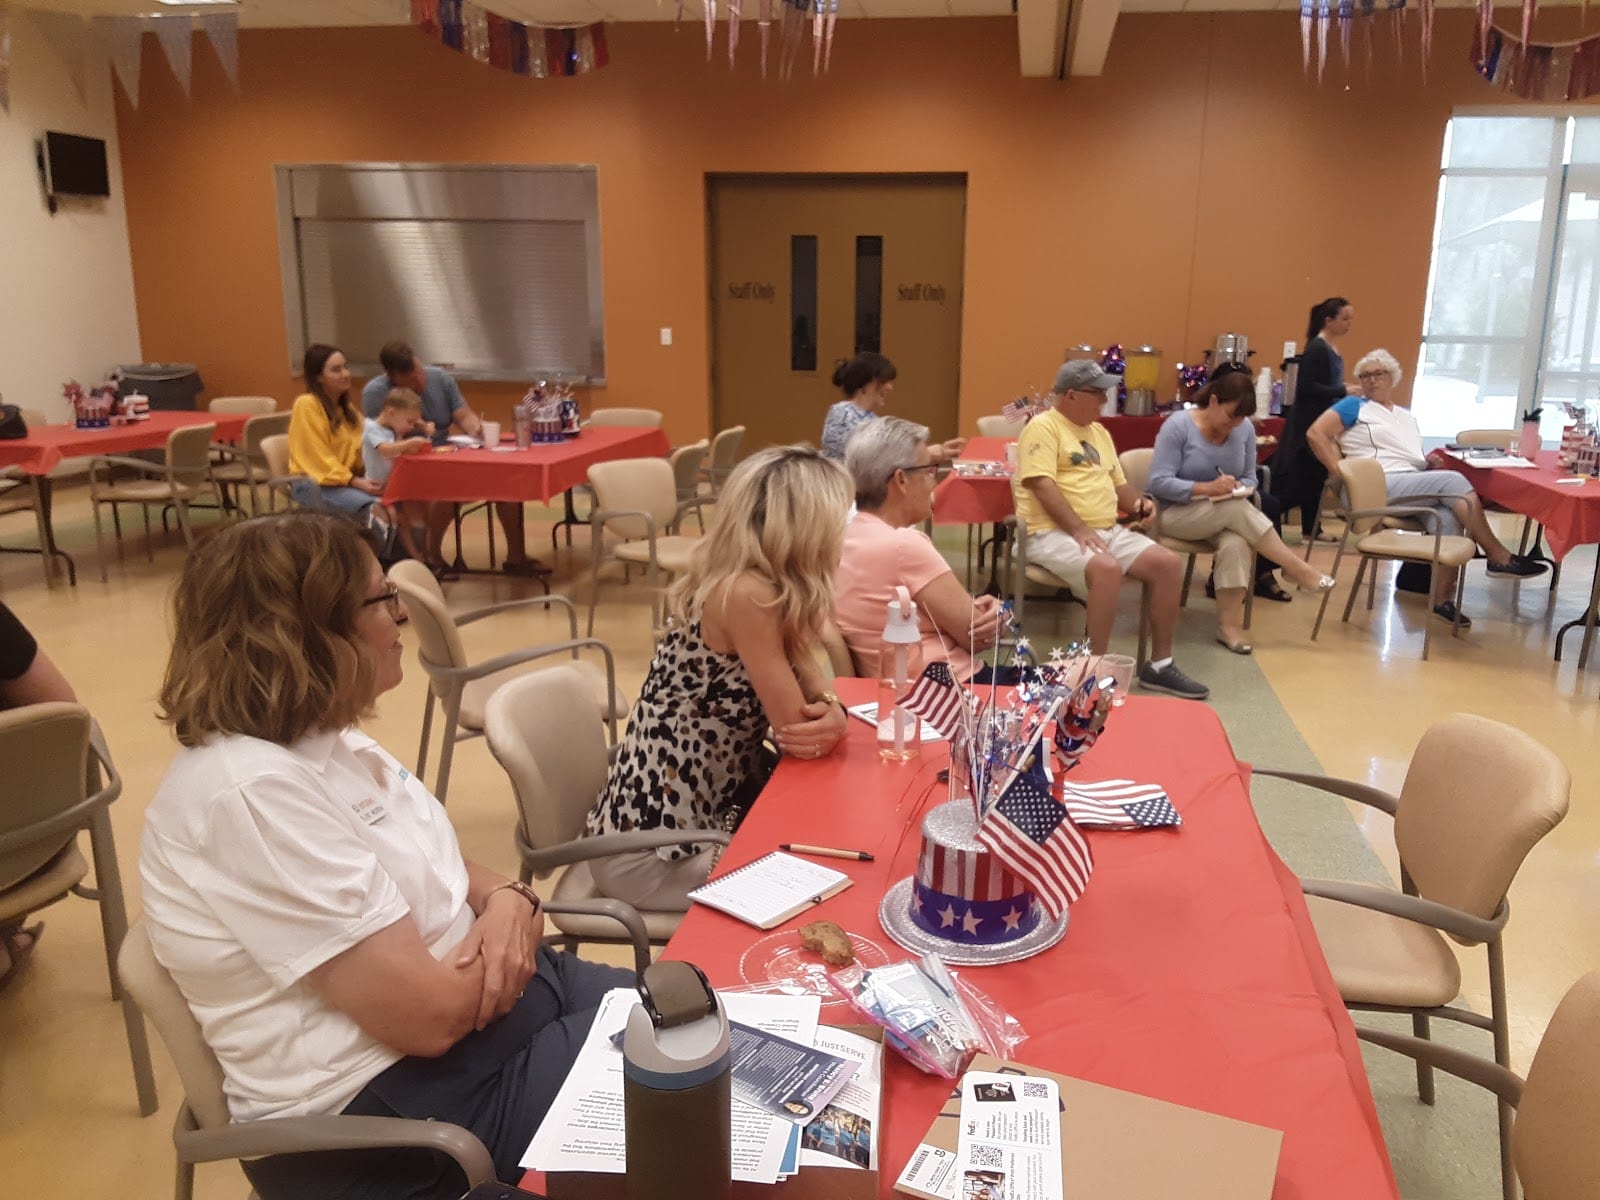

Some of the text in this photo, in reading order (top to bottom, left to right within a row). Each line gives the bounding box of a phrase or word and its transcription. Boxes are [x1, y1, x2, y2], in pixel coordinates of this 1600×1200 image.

[729, 281, 776, 304] Staff Only
[897, 282, 946, 305] Staff Only
